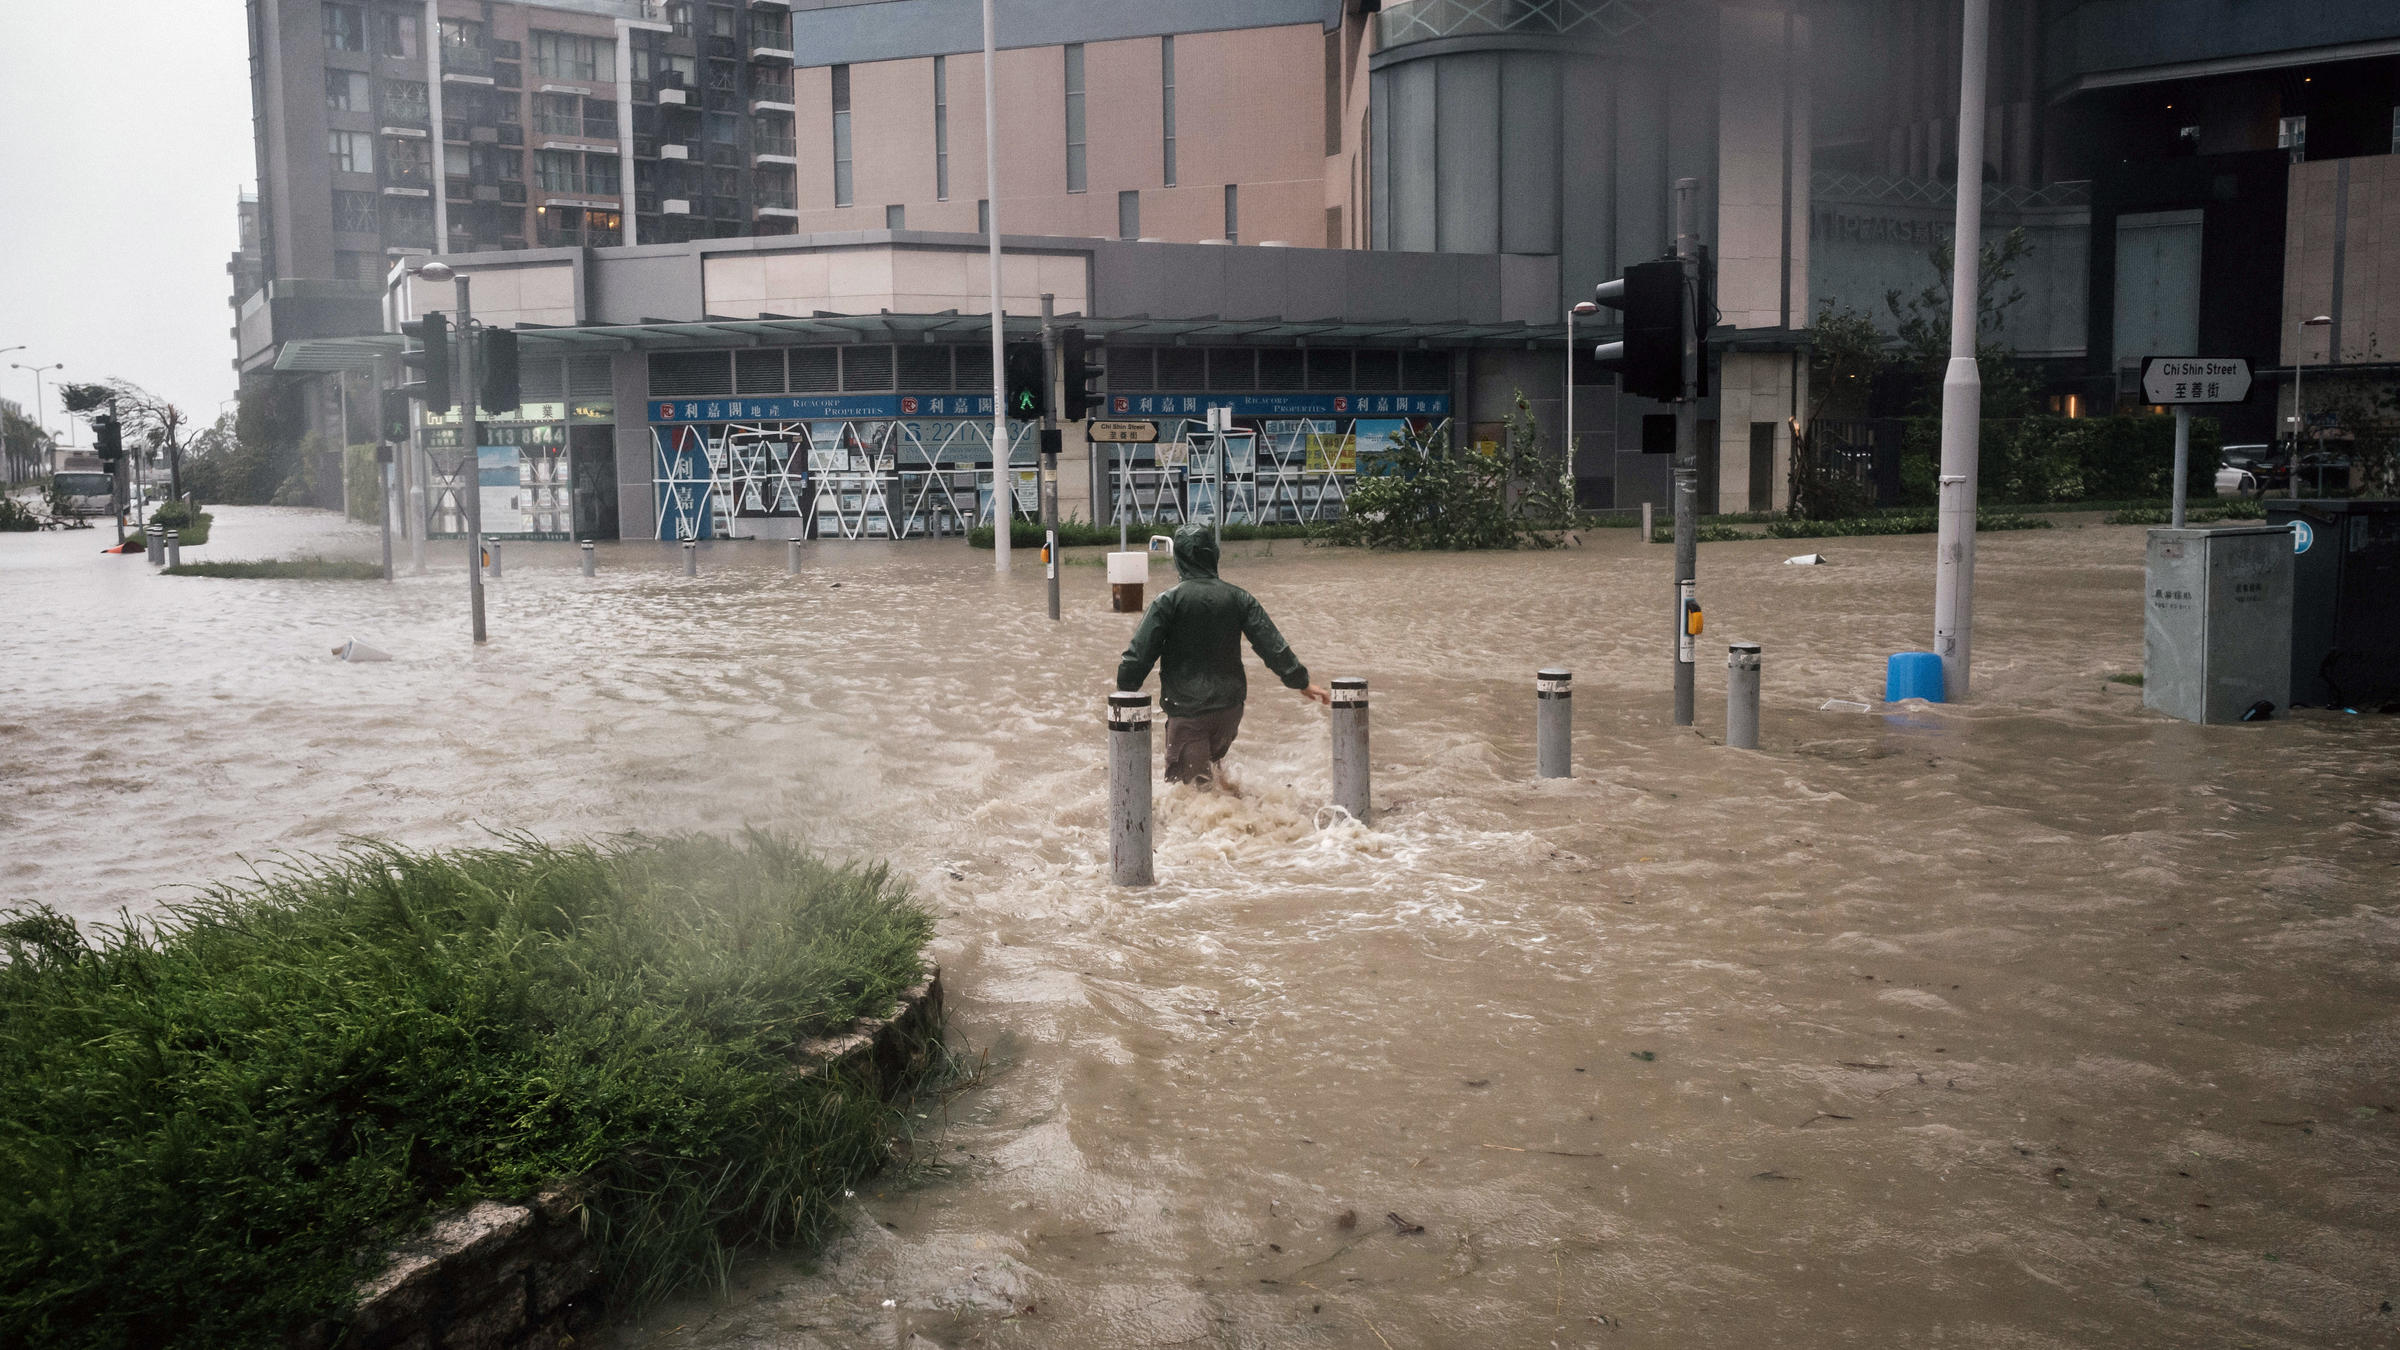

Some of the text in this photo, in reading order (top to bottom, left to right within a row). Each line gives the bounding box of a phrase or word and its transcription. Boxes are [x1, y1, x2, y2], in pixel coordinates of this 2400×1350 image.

[2163, 362, 2237, 375] Chi Shin Street
[2174, 382, 2219, 399] 至善街
[684, 402, 780, 418] 利嘉閣地產
[824, 407, 884, 416] PROPERTIES
[1356, 397, 1442, 412] 利嘉閣地產
[1127, 423, 1146, 431] Street
[675, 457, 695, 540] 利嘉閣
